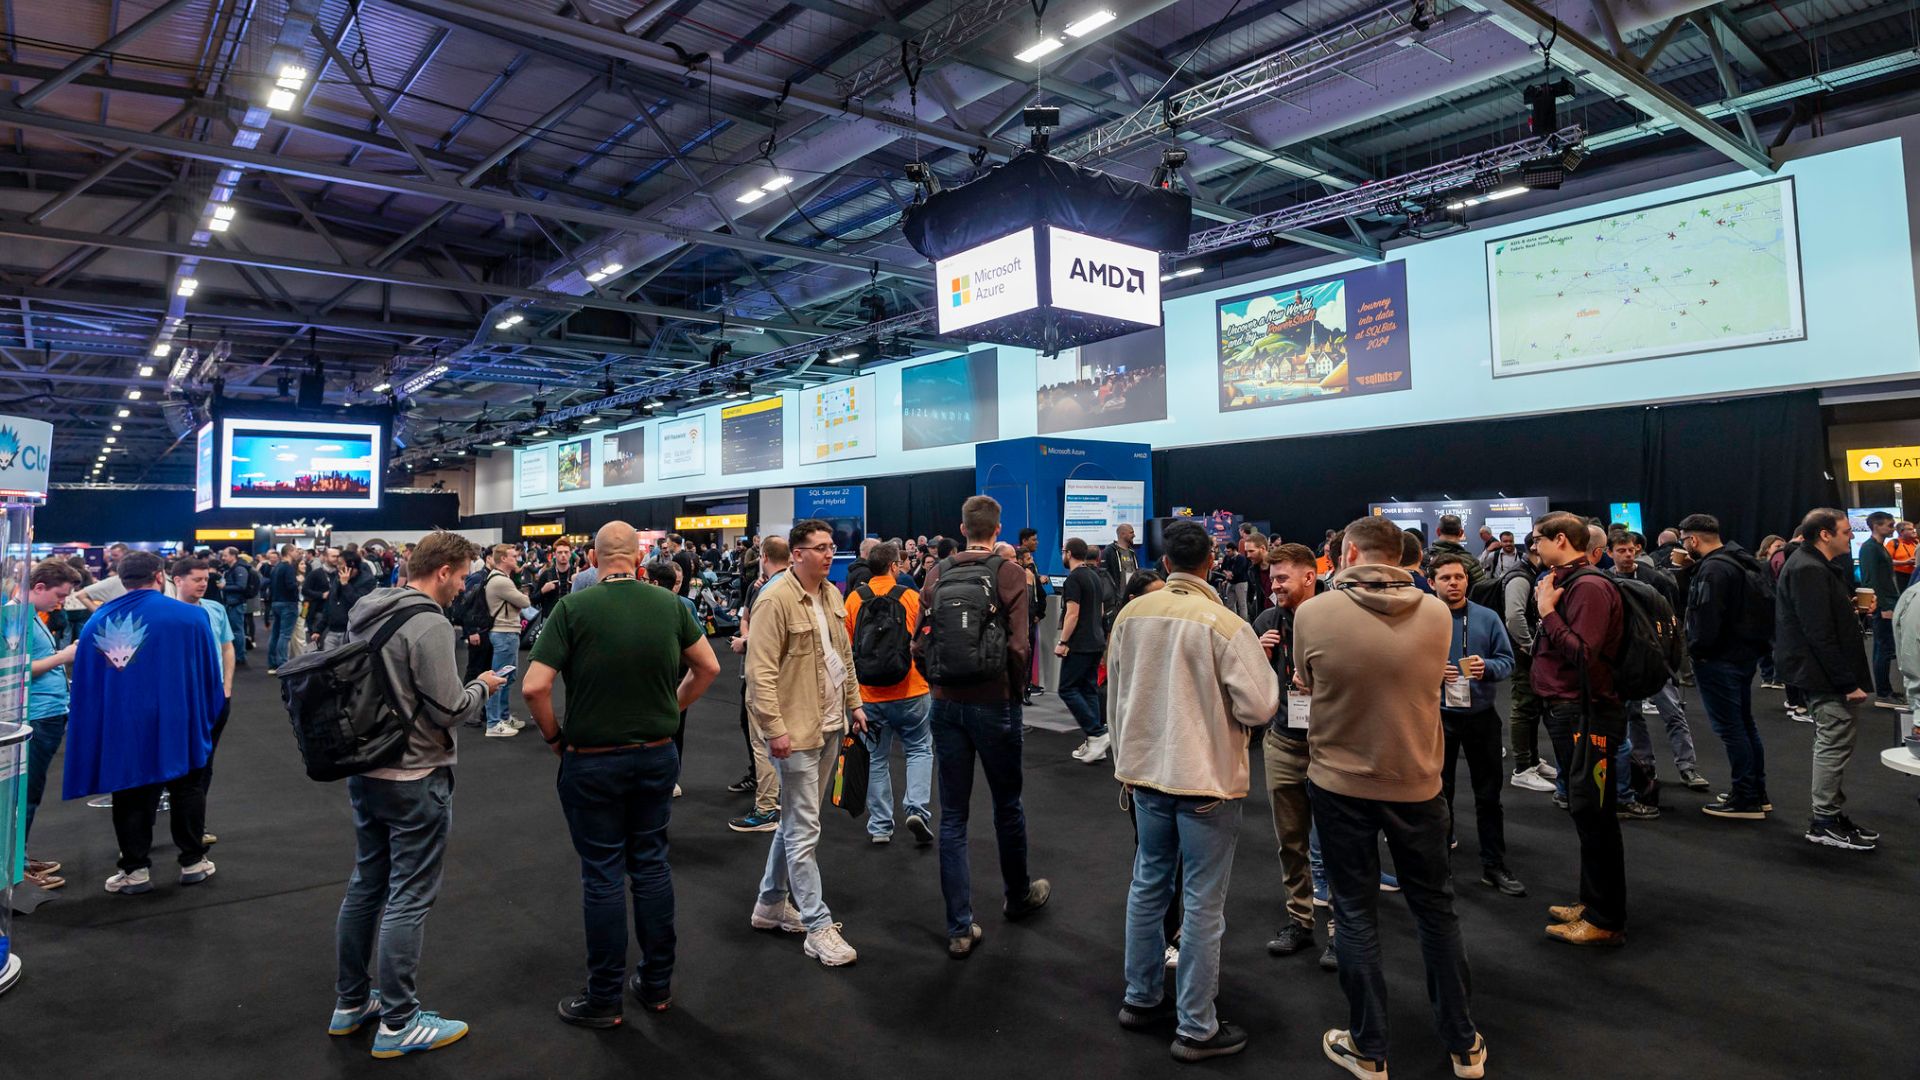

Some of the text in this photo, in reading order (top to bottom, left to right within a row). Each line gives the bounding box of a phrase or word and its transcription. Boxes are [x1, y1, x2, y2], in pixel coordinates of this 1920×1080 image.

[974, 257, 1022, 284] Microsoft
[1069, 257, 1125, 289] AMD
[976, 281, 1006, 301] Azure
[1357, 297, 1392, 314] Journey
[1227, 296, 1315, 337] Uncover a New World
[1358, 309, 1395, 326] into data
[1227, 337, 1244, 349] and
[1266, 310, 1317, 333] PowerShell
[1355, 322, 1397, 341] at SQLBits
[1366, 336, 1390, 350] 2024
[1365, 372, 1393, 385] sqlbits
[1048, 447, 1086, 457] Microsoft Azure
[808, 489, 820, 497] SQL
[825, 497, 846, 506] Hybrid
